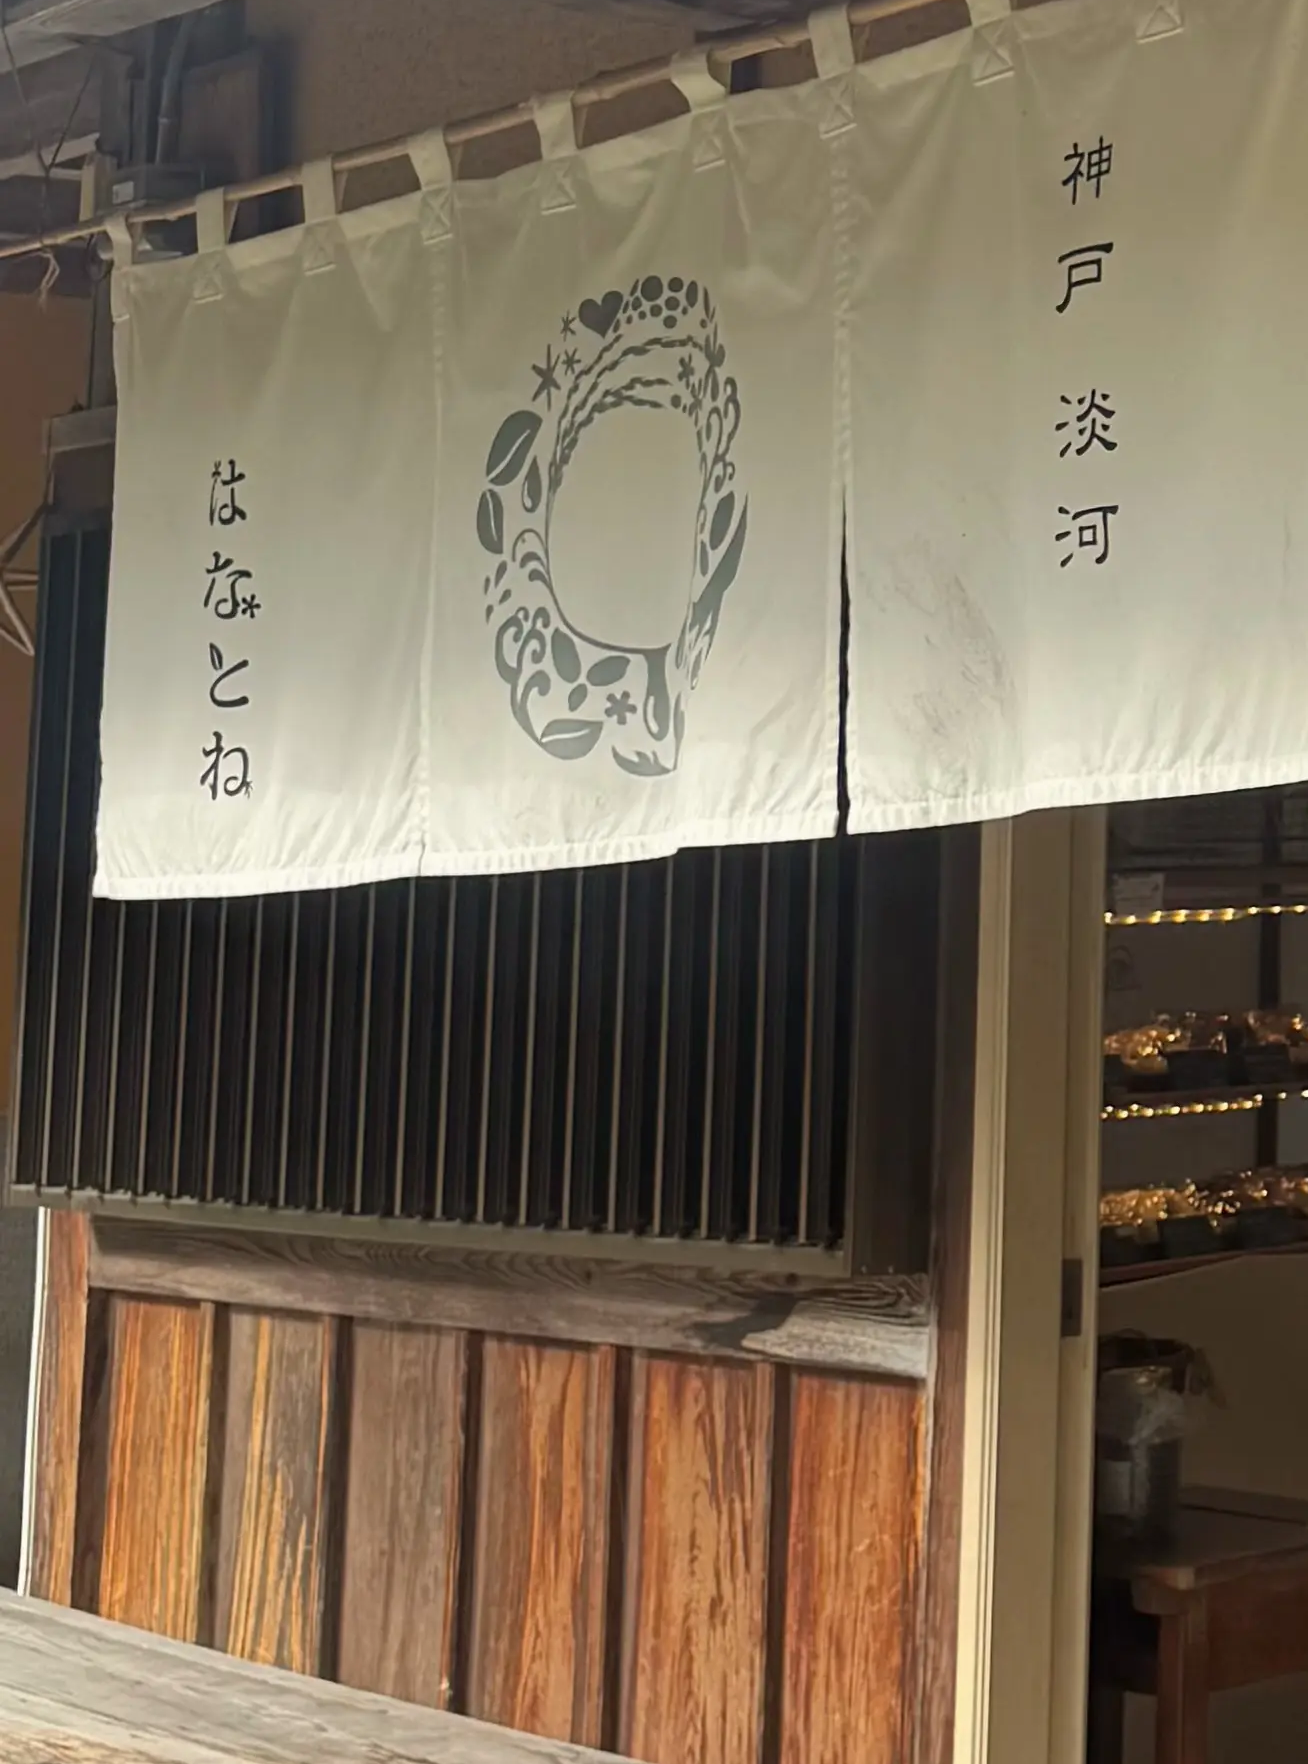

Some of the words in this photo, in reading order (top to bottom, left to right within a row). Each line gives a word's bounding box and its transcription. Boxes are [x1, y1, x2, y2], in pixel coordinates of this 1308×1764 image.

[1056, 135, 1115, 314] 神戸
[1054, 388, 1120, 568] 淡河
[200, 458, 263, 802] はなとね
